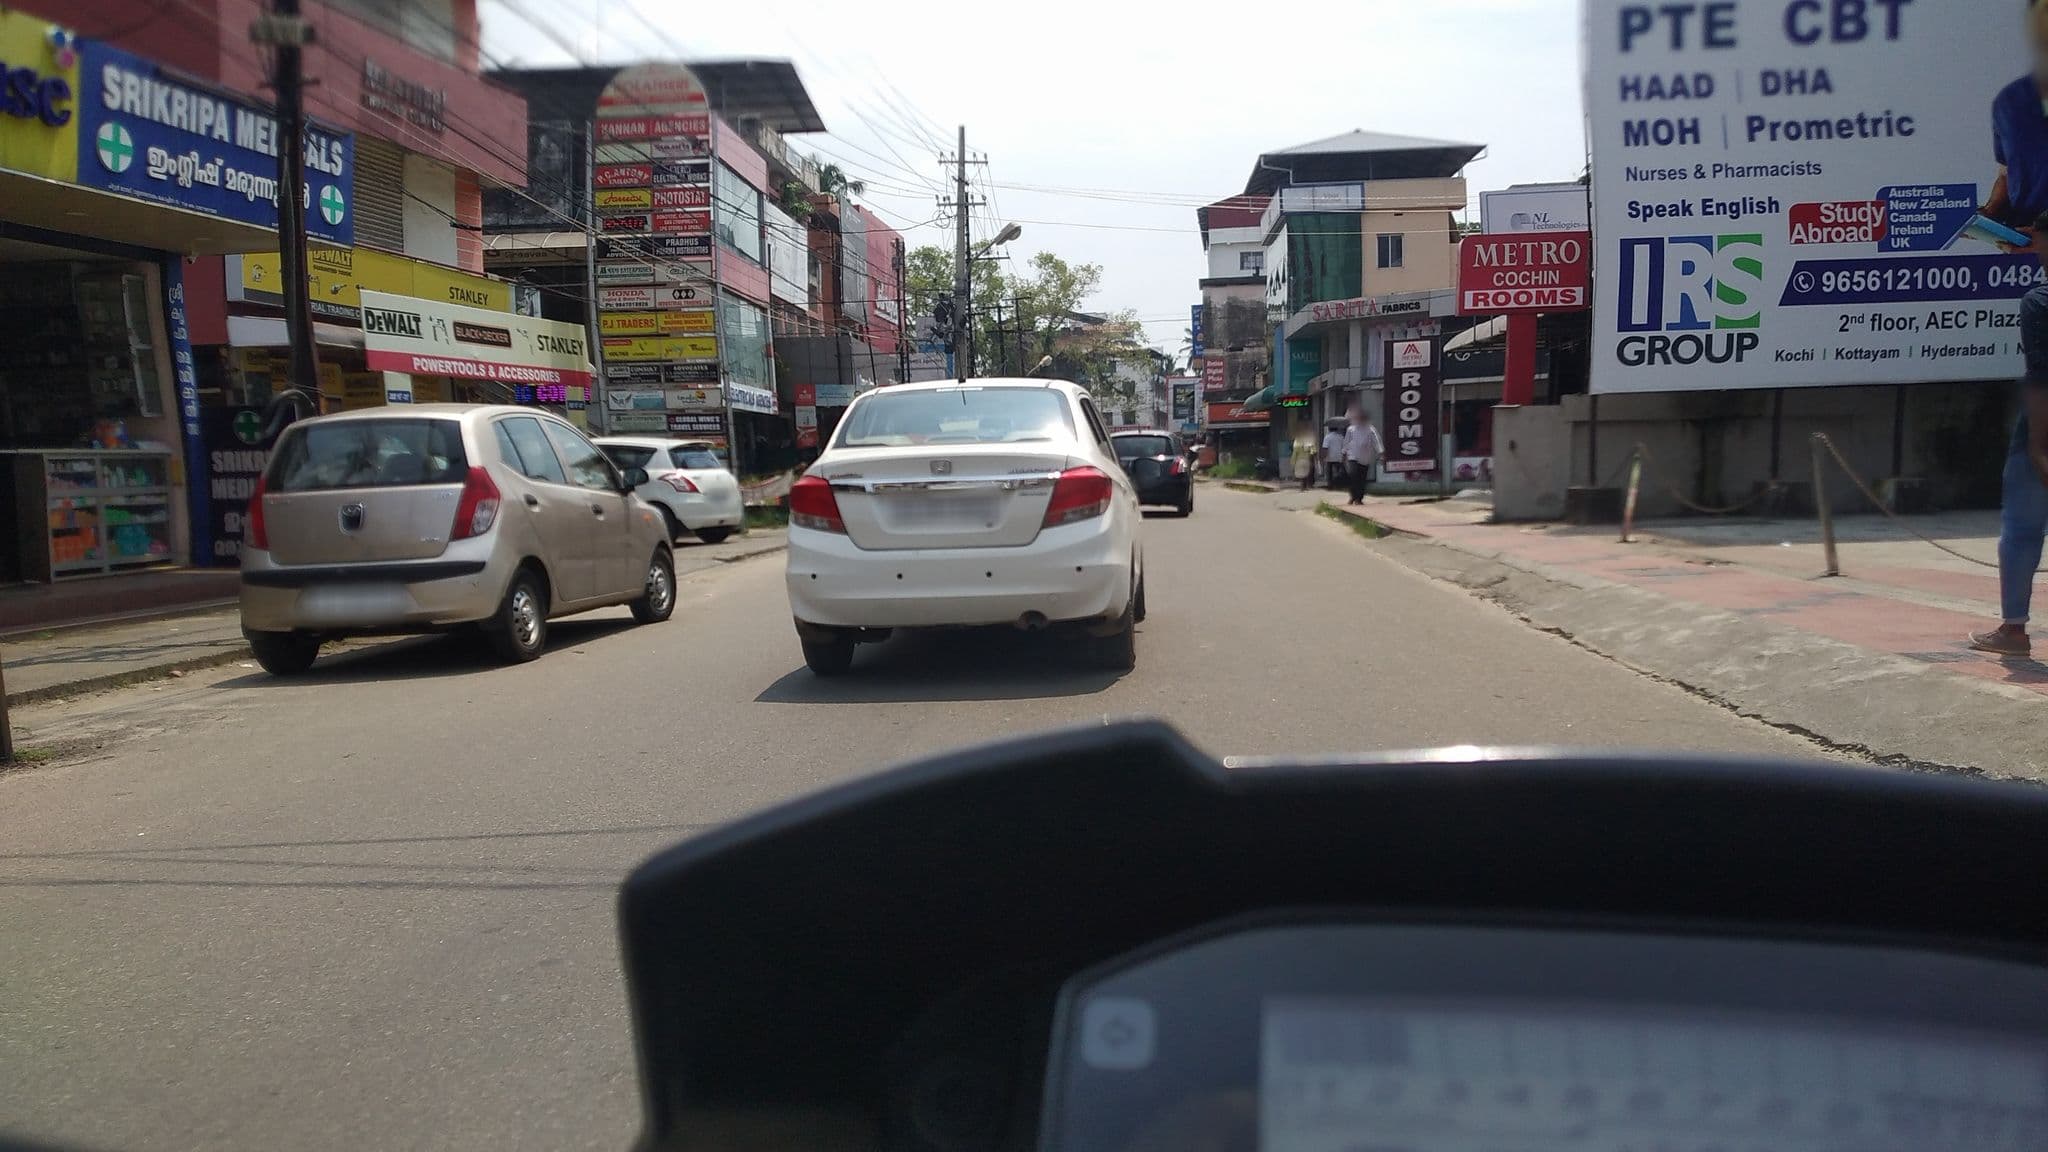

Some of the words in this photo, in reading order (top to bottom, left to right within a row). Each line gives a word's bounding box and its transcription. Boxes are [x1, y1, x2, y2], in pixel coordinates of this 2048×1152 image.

[1618, 2, 1737, 52] PTE
[1783, 0, 1911, 46] CBT
[1619, 73, 1714, 101] HAAD
[1761, 68, 1834, 97] DHA
[102, 64, 230, 143] SRIKRIPA
[1623, 118, 1701, 146] MOH
[1746, 111, 1915, 143] Prometric
[1626, 165, 1687, 181] Nurses
[1693, 163, 1706, 179] &
[1712, 160, 1822, 179] Pharmacists
[1888, 187, 1945, 198] Australia
[1627, 199, 1694, 222] Speak
[1701, 196, 1780, 220] English
[1820, 201, 1885, 227] Study
[1889, 200, 1917, 210] New
[1921, 197, 1970, 209] Zealand
[1532, 221, 1580, 231] Technologies
[1534, 212, 1550, 223] NL
[1890, 211, 1937, 223] Canada
[1790, 223, 1872, 244] Abroad
[1891, 224, 1934, 235] Ireland
[1472, 239, 1581, 267] METRO
[1891, 237, 1910, 248] UK
[1493, 270, 1560, 287] COCHIN
[1617, 233, 1762, 332] IRS
[1821, 267, 1979, 293] 9656121000,
[1988, 264, 2048, 287] 0484
[449, 286, 488, 306] STANLEY
[608, 289, 646, 297] HONDA
[1472, 289, 1577, 307] ROOMS
[1312, 297, 1380, 321] SARITA
[1382, 302, 1421, 314] FABRICS
[617, 319, 655, 328] TRADERS
[1870, 312, 1920, 334] floor,
[1925, 311, 1968, 330] AEC
[537, 334, 585, 356] STANLEY
[1616, 332, 1759, 366] GROUP
[1774, 349, 1815, 363] Kochi
[1835, 346, 1900, 363] Kottayam
[1921, 344, 1996, 361] Hyderabad
[413, 356, 486, 377] POWERTOOLS
[488, 367, 496, 378] &
[498, 367, 561, 383] ACCESSORIES
[1398, 372, 1423, 456] ROOMS
